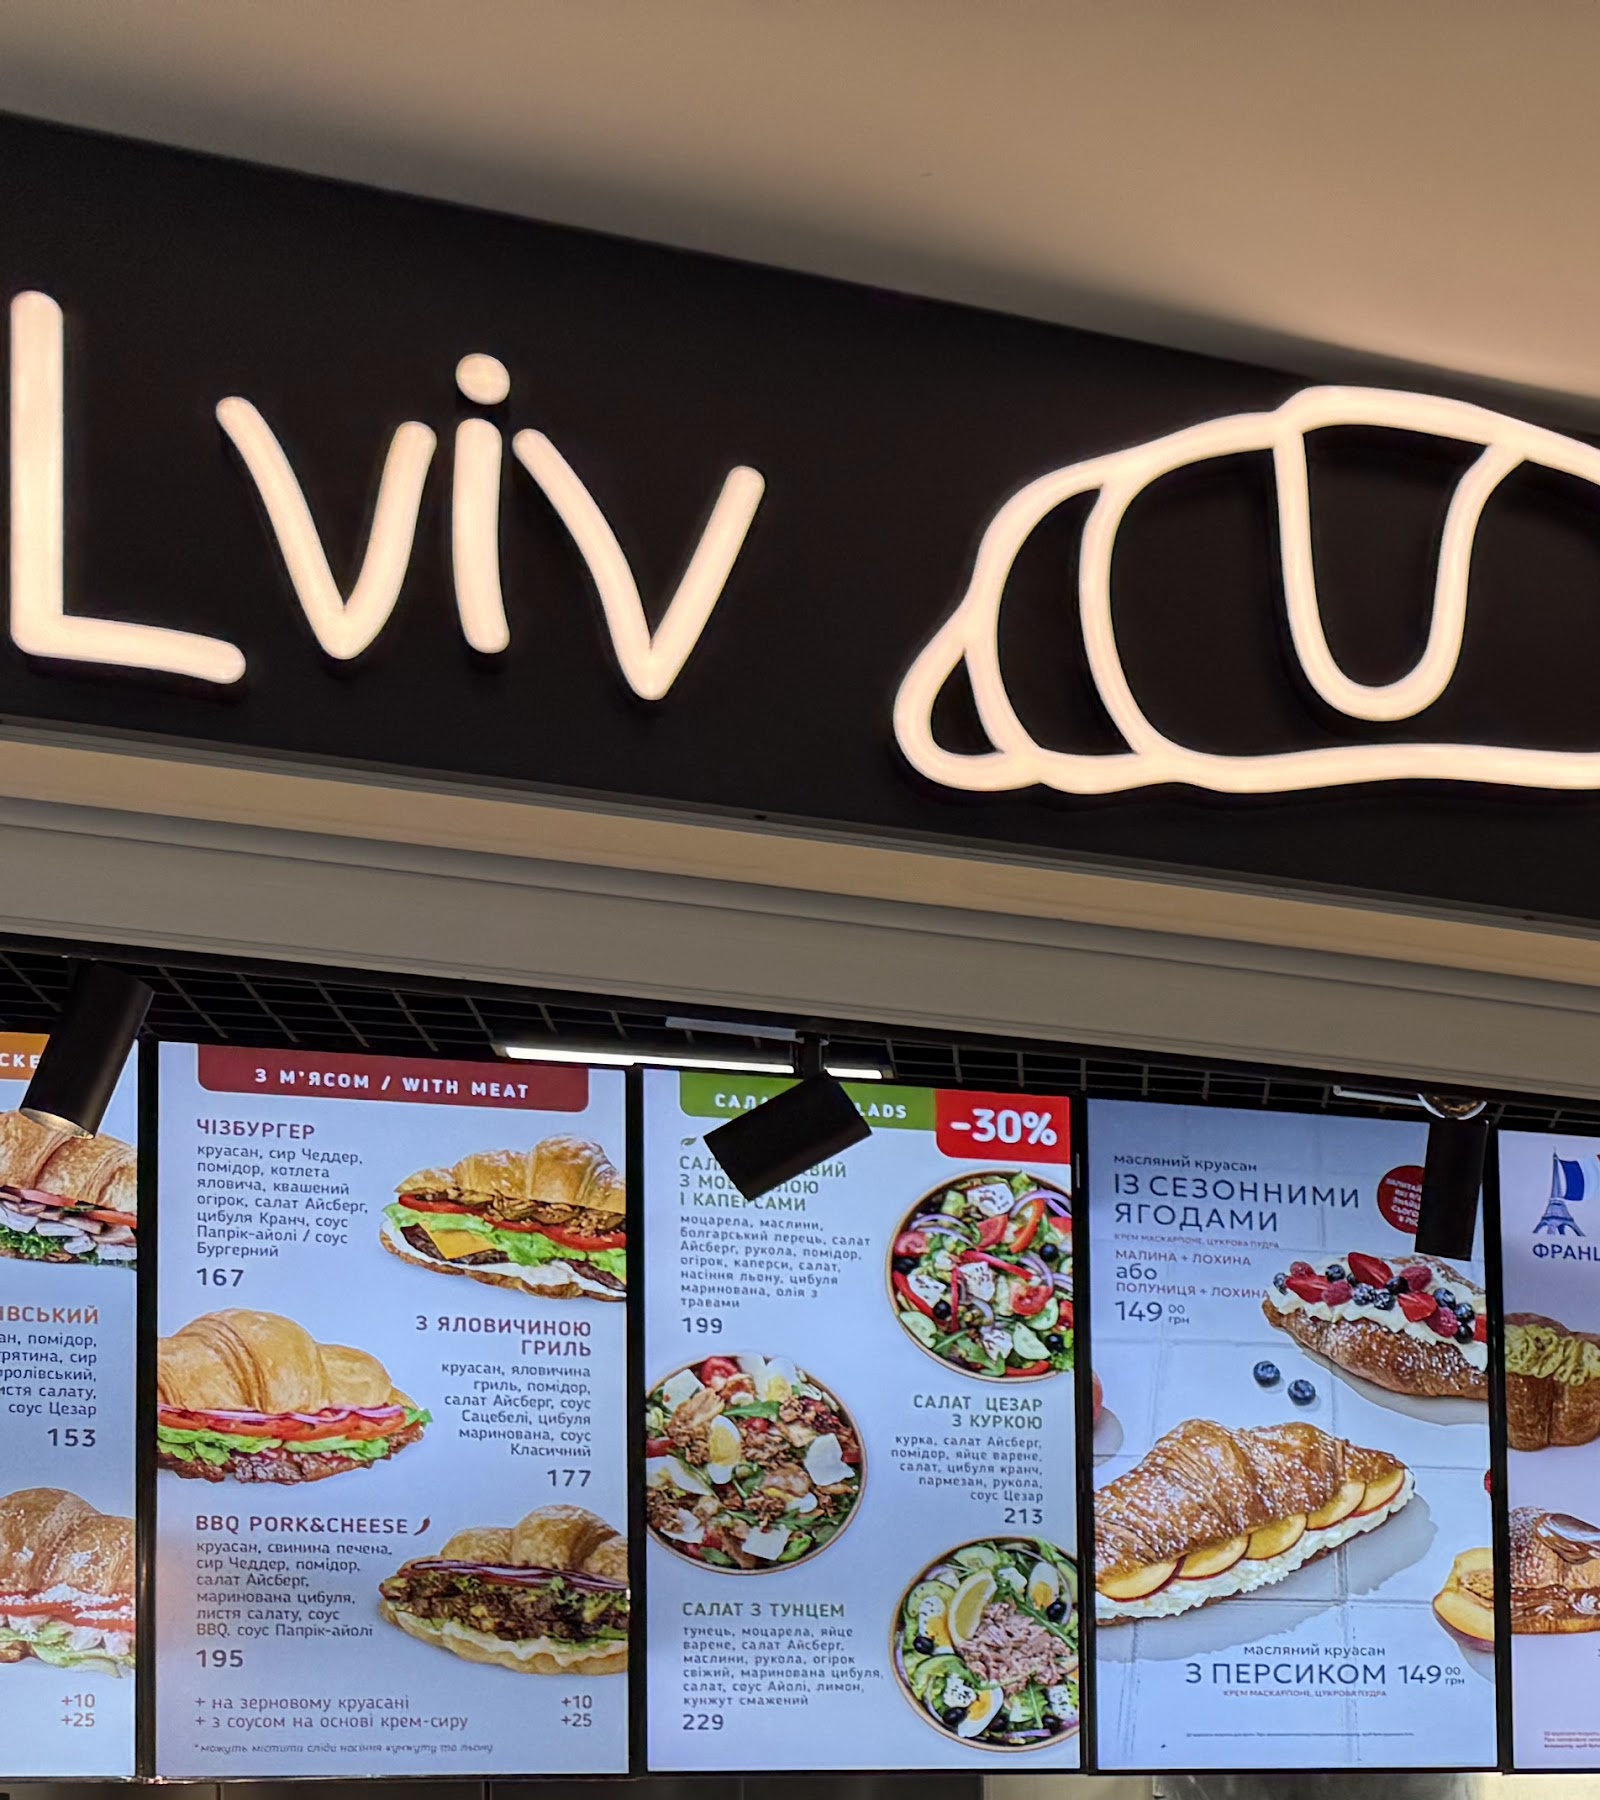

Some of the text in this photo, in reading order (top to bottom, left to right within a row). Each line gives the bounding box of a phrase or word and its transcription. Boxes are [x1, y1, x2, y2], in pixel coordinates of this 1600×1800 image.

[11, 290, 766, 700] Lviv
[280, 1070, 370, 1088] М'ЯСОМ
[402, 1077, 458, 1095] WITH
[472, 1082, 529, 1098] MEAT
[197, 1118, 314, 1139] ЧІЗБУРГЕР
[951, 1108, 1058, 1146] -30%
[269, 1149, 295, 1163] сир
[1114, 1154, 1257, 1172] масляний круасан
[197, 1162, 329, 1178] помідор, котлета
[274, 1180, 349, 1195] квашений
[1115, 1173, 1139, 1194] ІЗ
[1150, 1176, 1359, 1208] СЕЗОННИМИ
[255, 1197, 298, 1209] салат
[305, 1197, 368, 1214] Айсберг,
[693, 1193, 806, 1211] КАПЕРСАМИ
[197, 1211, 252, 1226] цибуля
[316, 1216, 348, 1228] соус
[1115, 1202, 1278, 1232] ЯГОДАМИ
[197, 1225, 296, 1243] Папрік-айолі
[315, 1233, 348, 1244] соус
[197, 1243, 278, 1259] Бургерний
[1115, 1250, 1251, 1266] МАЛИНА ЛОХИНА
[197, 1268, 244, 1287] 167
[1116, 1263, 1157, 1280] або
[1116, 1282, 1269, 1299] ПОЛУНИЦЯ ЛОХИНА
[1114, 1301, 1162, 1322] 149
[1168, 1315, 1190, 1325] грн
[416, 1315, 591, 1336] З ЯЛОВИЧИНОЮ
[681, 1317, 723, 1334] 199
[28, 1332, 96, 1349] помідор,
[522, 1341, 591, 1356] ГРИЛЬ
[511, 1365, 590, 1378] яловичина
[527, 1380, 590, 1395] помідор,
[9, 1401, 97, 1417] соус Цезар
[444, 1395, 591, 1410] салат Айсберг, соус
[913, 1395, 1043, 1414] САЛАТ ЦЕЗАР
[538, 1413, 590, 1426] цибуля
[969, 1414, 1043, 1429] КУРКОЮ
[47, 1428, 97, 1447] 153
[561, 1431, 591, 1443] соус
[511, 1443, 591, 1456] Класичний
[547, 1470, 591, 1487] 177
[196, 1515, 408, 1534] BBQ PORK&CHEESE
[1004, 1508, 1043, 1524] 213
[683, 1602, 845, 1619] САЛАТ З ТУНЦЕМ
[196, 1649, 243, 1667] 195
[1244, 1644, 1385, 1658] масляний круасан
[1185, 1663, 1386, 1685] З ПЕРСИКОМ
[1397, 1665, 1442, 1685] 149
[62, 1693, 95, 1707] +10
[212, 1695, 592, 1713] на зерновому круасані +10
[61, 1713, 95, 1727] +25
[227, 1717, 285, 1730] соусом
[292, 1717, 313, 1727] на
[320, 1714, 374, 1728] основі
[381, 1716, 468, 1732] крем-сиру
[561, 1713, 592, 1727] +25
[683, 1714, 724, 1731] 229
